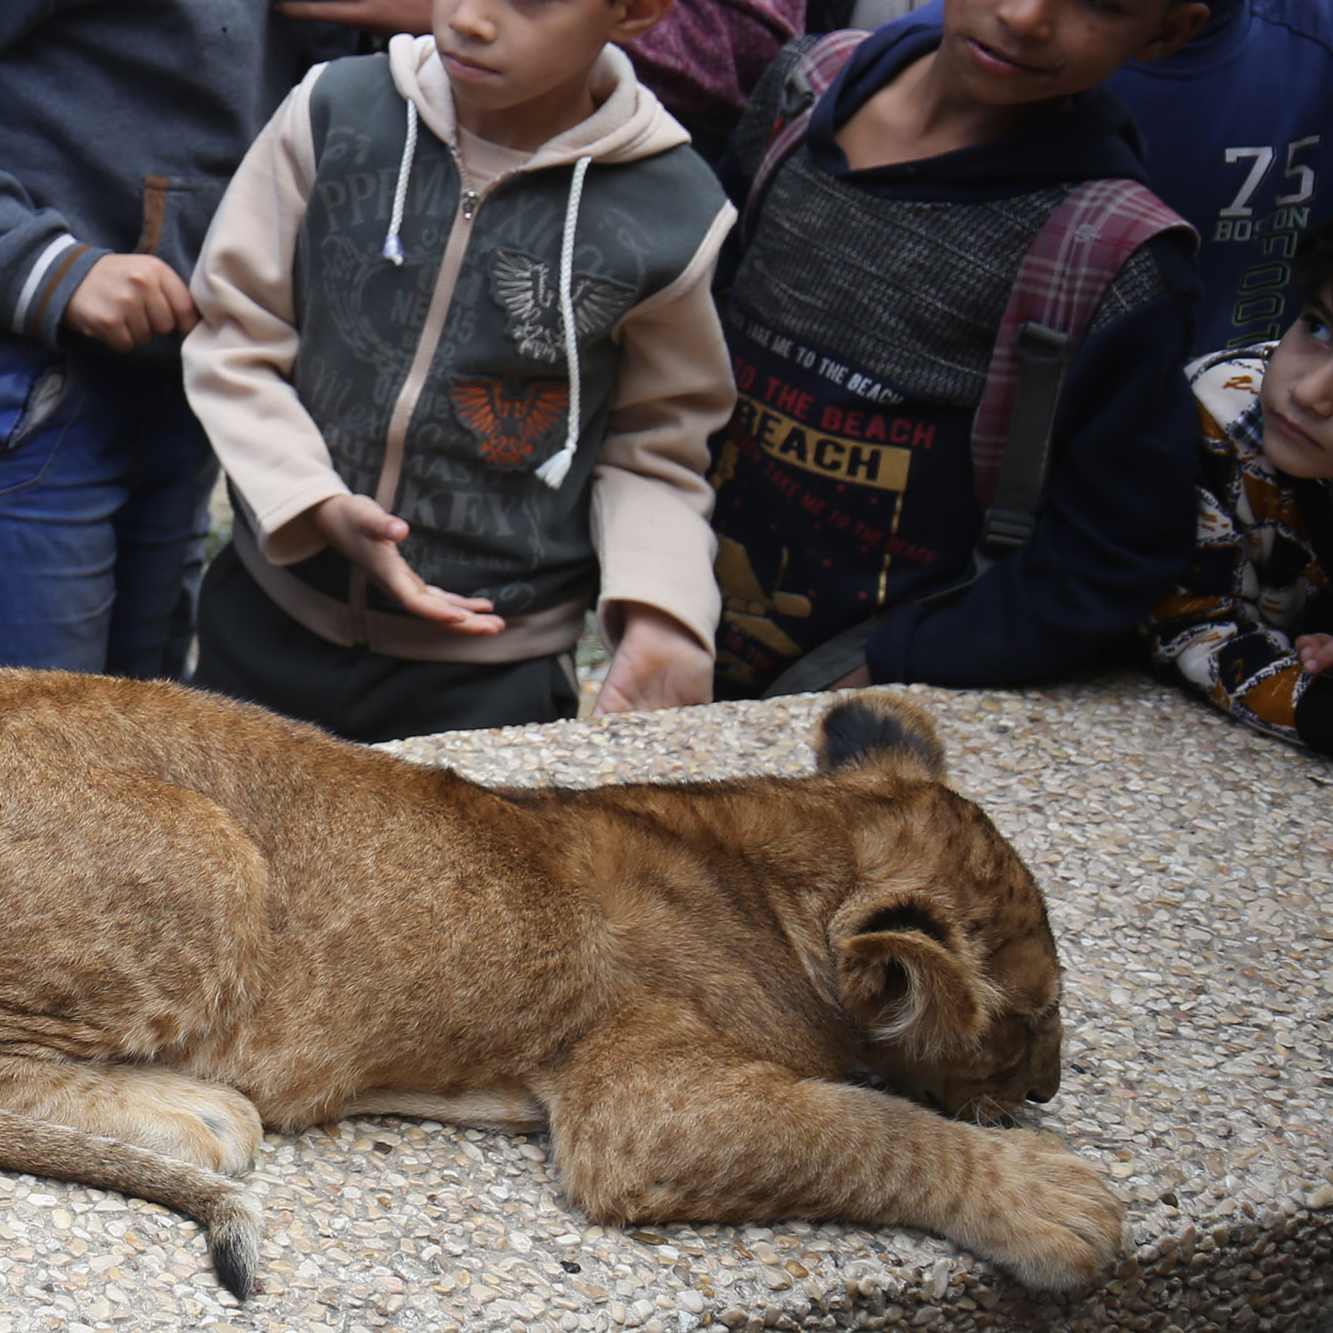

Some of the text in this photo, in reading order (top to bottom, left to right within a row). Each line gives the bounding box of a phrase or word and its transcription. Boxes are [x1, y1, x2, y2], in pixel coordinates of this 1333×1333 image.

[1220, 134, 1321, 217] 75
[818, 357, 850, 386] THE
[736, 400, 883, 482] BEACH
[763, 374, 816, 422] THE
[821, 405, 937, 450] BEACH
